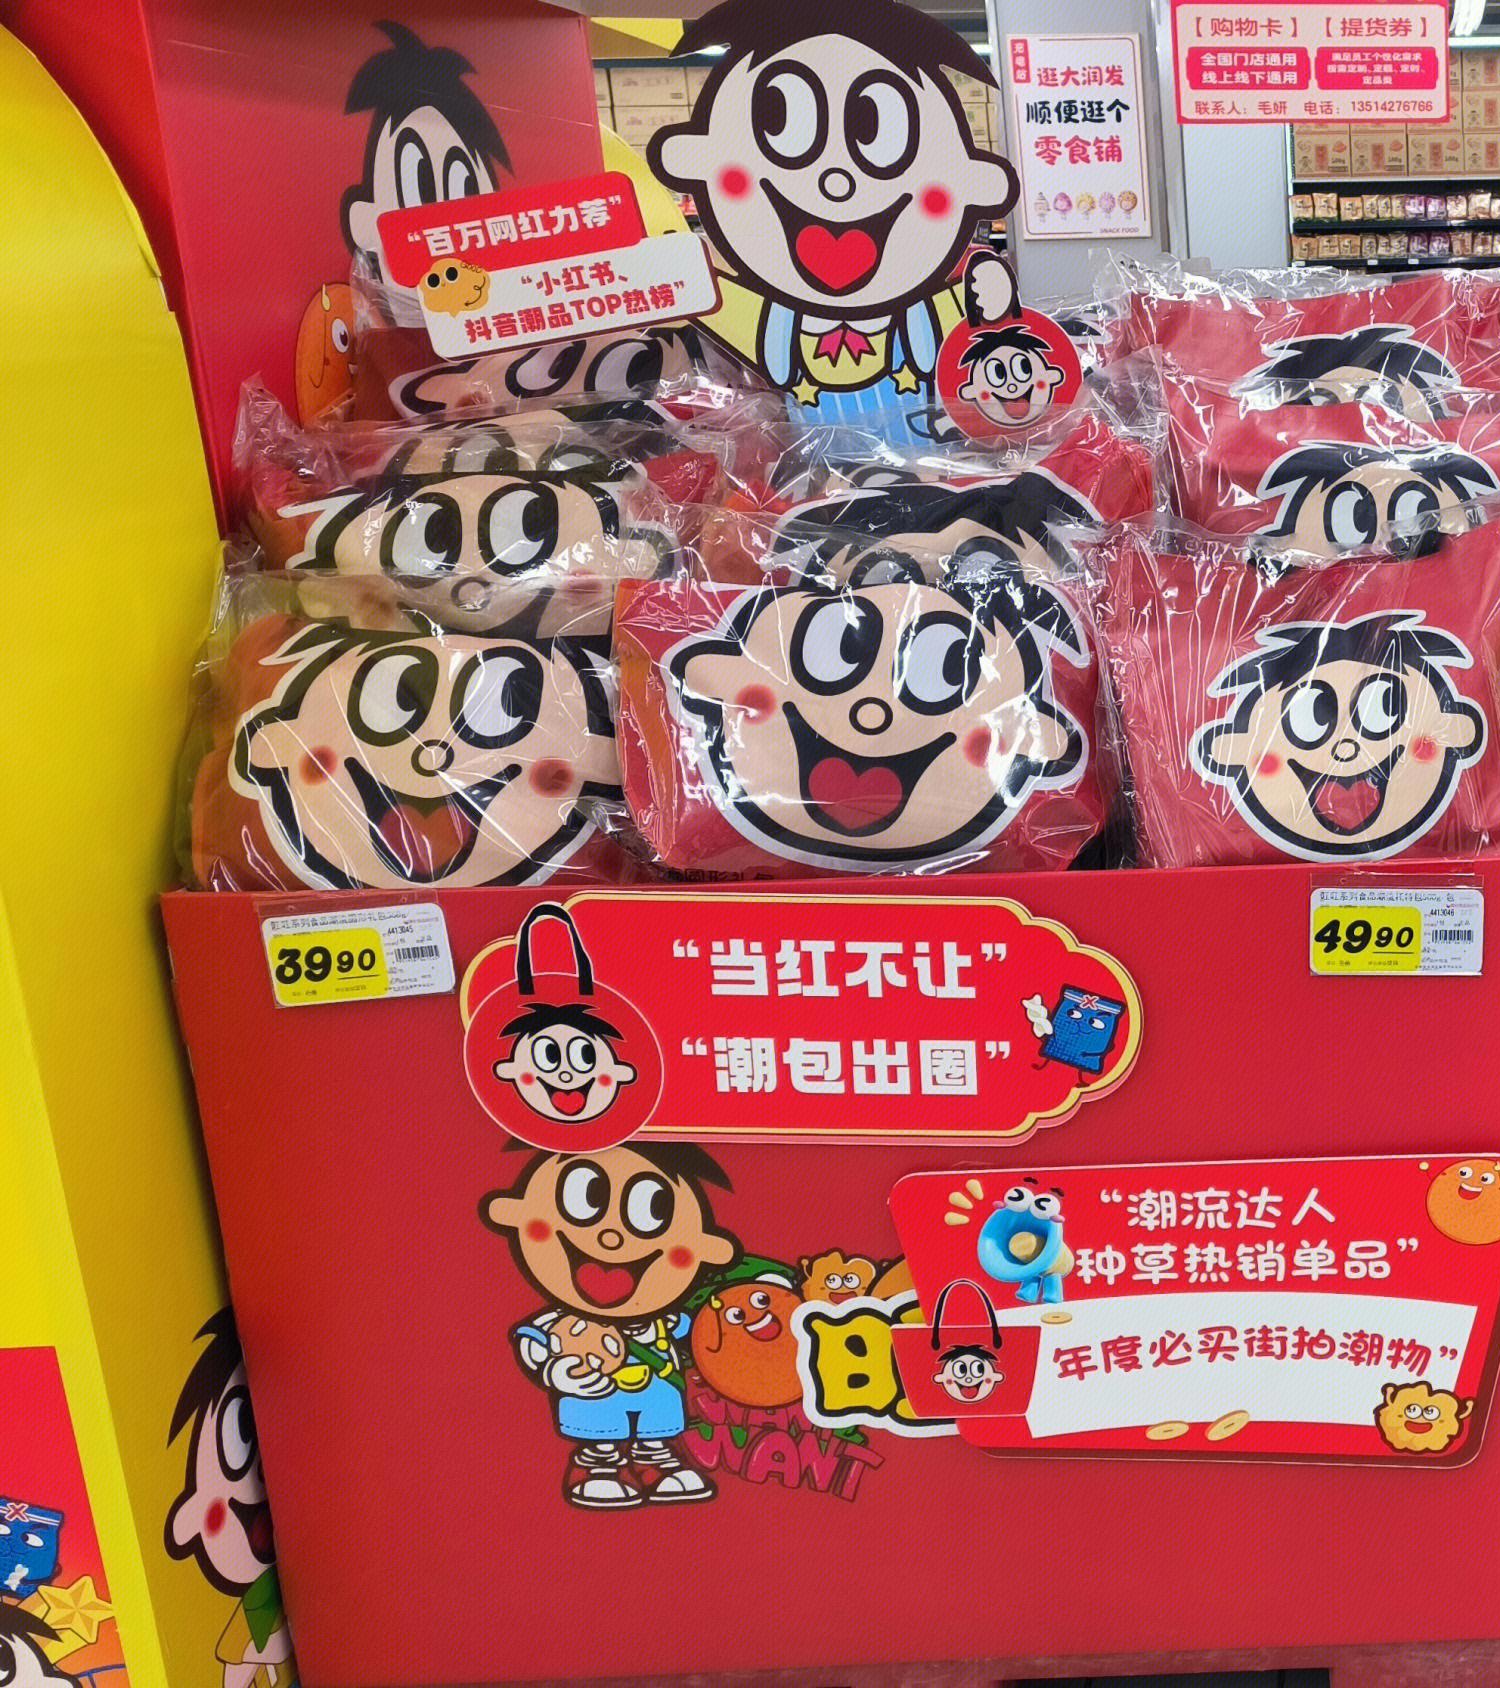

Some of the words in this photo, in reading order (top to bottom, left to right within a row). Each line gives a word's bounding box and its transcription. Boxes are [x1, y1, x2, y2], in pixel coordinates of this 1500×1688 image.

[1036, 65, 1125, 87] 逛大润发
[1200, 52, 1298, 67] 全国门店通用
[1201, 71, 1298, 85] 线上线下通用
[1026, 98, 1130, 124] 顺便逛个
[1350, 100, 1433, 113] 13514276766
[1034, 134, 1123, 166] 零食铺
[671, 937, 1009, 999] “当红不让”
[680, 1034, 1012, 1097] “潮包出圈”
[1098, 1187, 1337, 1232] “潮流达人
[1073, 1236, 1421, 1286] 种草热销单品”
[1051, 1323, 1460, 1382] 年度必买街拍潮物”
[681, 1424, 886, 1503] WANT
